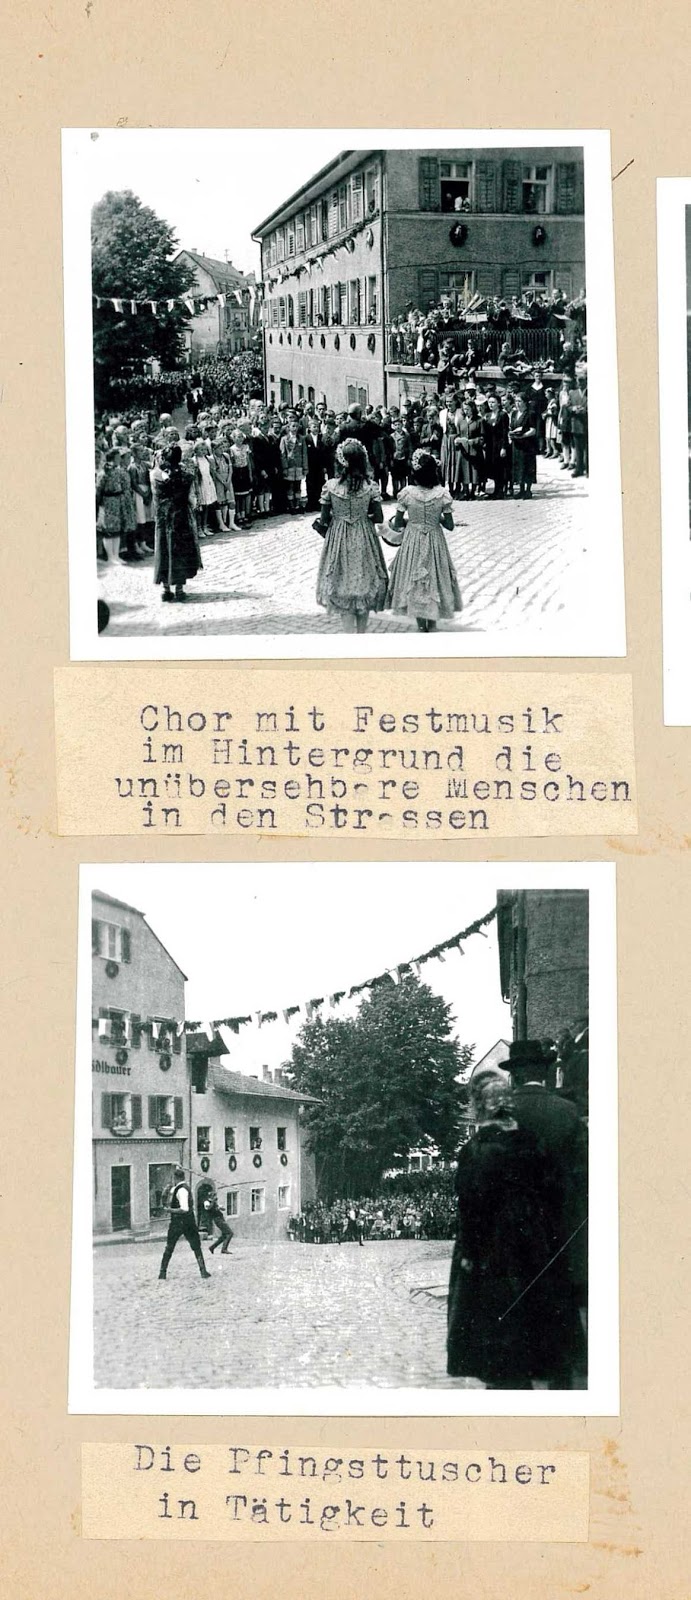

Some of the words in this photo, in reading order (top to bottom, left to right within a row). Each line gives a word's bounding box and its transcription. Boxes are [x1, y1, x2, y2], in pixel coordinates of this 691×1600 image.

[140, 704, 233, 732] Chor
[256, 705, 325, 732] mit
[352, 706, 564, 734] Festmusik
[142, 737, 184, 763] im
[212, 738, 464, 774] Hintergrund
[495, 745, 563, 773] die
[445, 775, 631, 802] Menschen
[142, 802, 183, 828] in
[211, 802, 278, 829] den
[134, 1444, 202, 1474] Die
[228, 1447, 556, 1485] Pfingsttuscher
[158, 1492, 200, 1520] in
[225, 1495, 435, 1532] Tätigkeit
